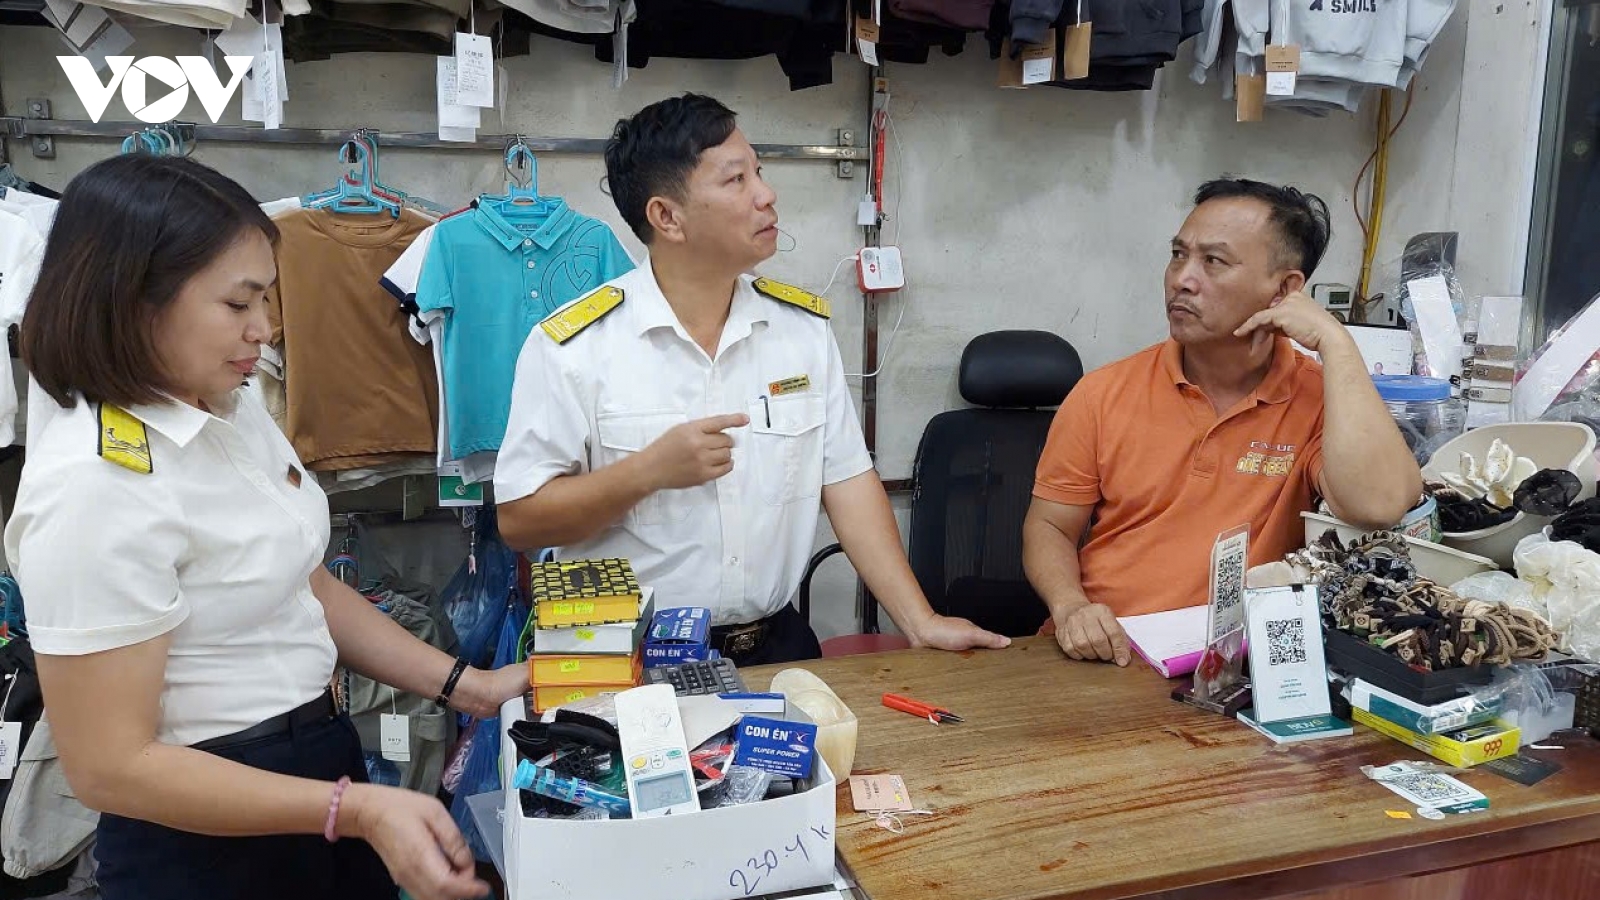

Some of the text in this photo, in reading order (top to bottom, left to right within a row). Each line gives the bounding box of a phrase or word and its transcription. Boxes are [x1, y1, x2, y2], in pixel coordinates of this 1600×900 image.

[1331, 0, 1376, 13] SMILE
[646, 648, 666, 657] CON
[745, 725, 789, 742] CON ÉN
[753, 746, 800, 759] SUPER POWER
[1484, 739, 1502, 757] 999
